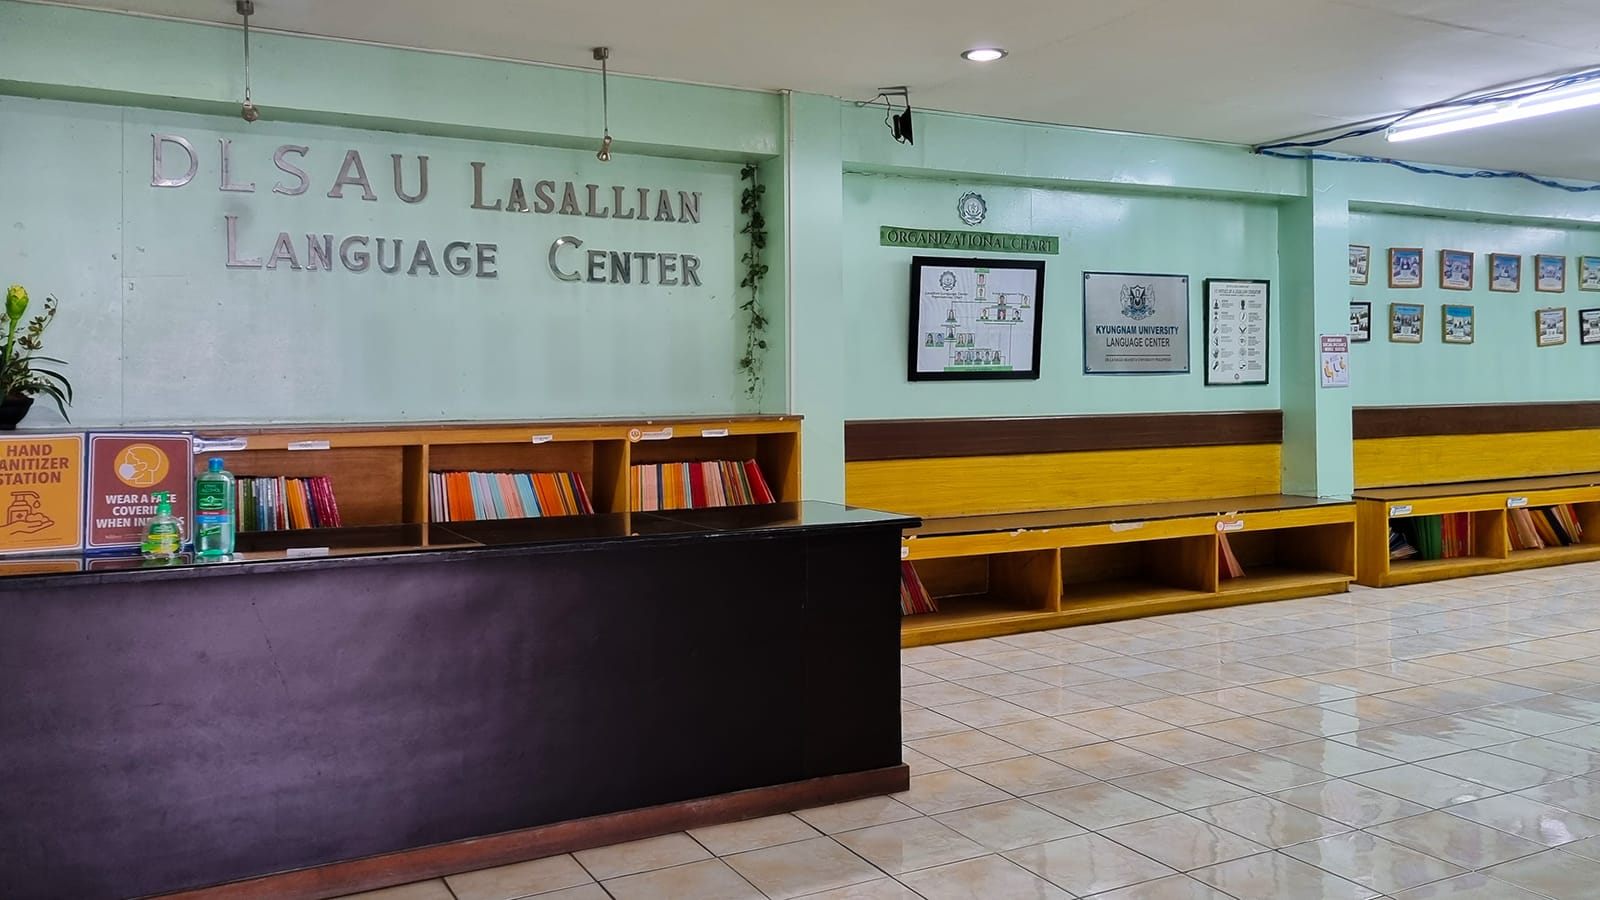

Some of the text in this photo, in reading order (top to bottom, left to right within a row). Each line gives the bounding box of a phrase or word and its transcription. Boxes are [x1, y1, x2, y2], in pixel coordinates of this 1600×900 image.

[150, 132, 703, 225] DLSAU LASALLIAN
[886, 229, 1052, 253] ORGANIZATIONAL CHART
[224, 215, 702, 287] LANGUAGE CENTER
[1095, 325, 1179, 336] KYUNGNAM UNIVERSITY
[1106, 337, 1170, 348] LANGUAGE CENTER
[7, 444, 52, 457] HAND
[0, 457, 69, 471] ANITIZER
[105, 493, 177, 504] WEAR A FAE
[112, 505, 163, 516] COVERI
[96, 518, 133, 529] WHEN
